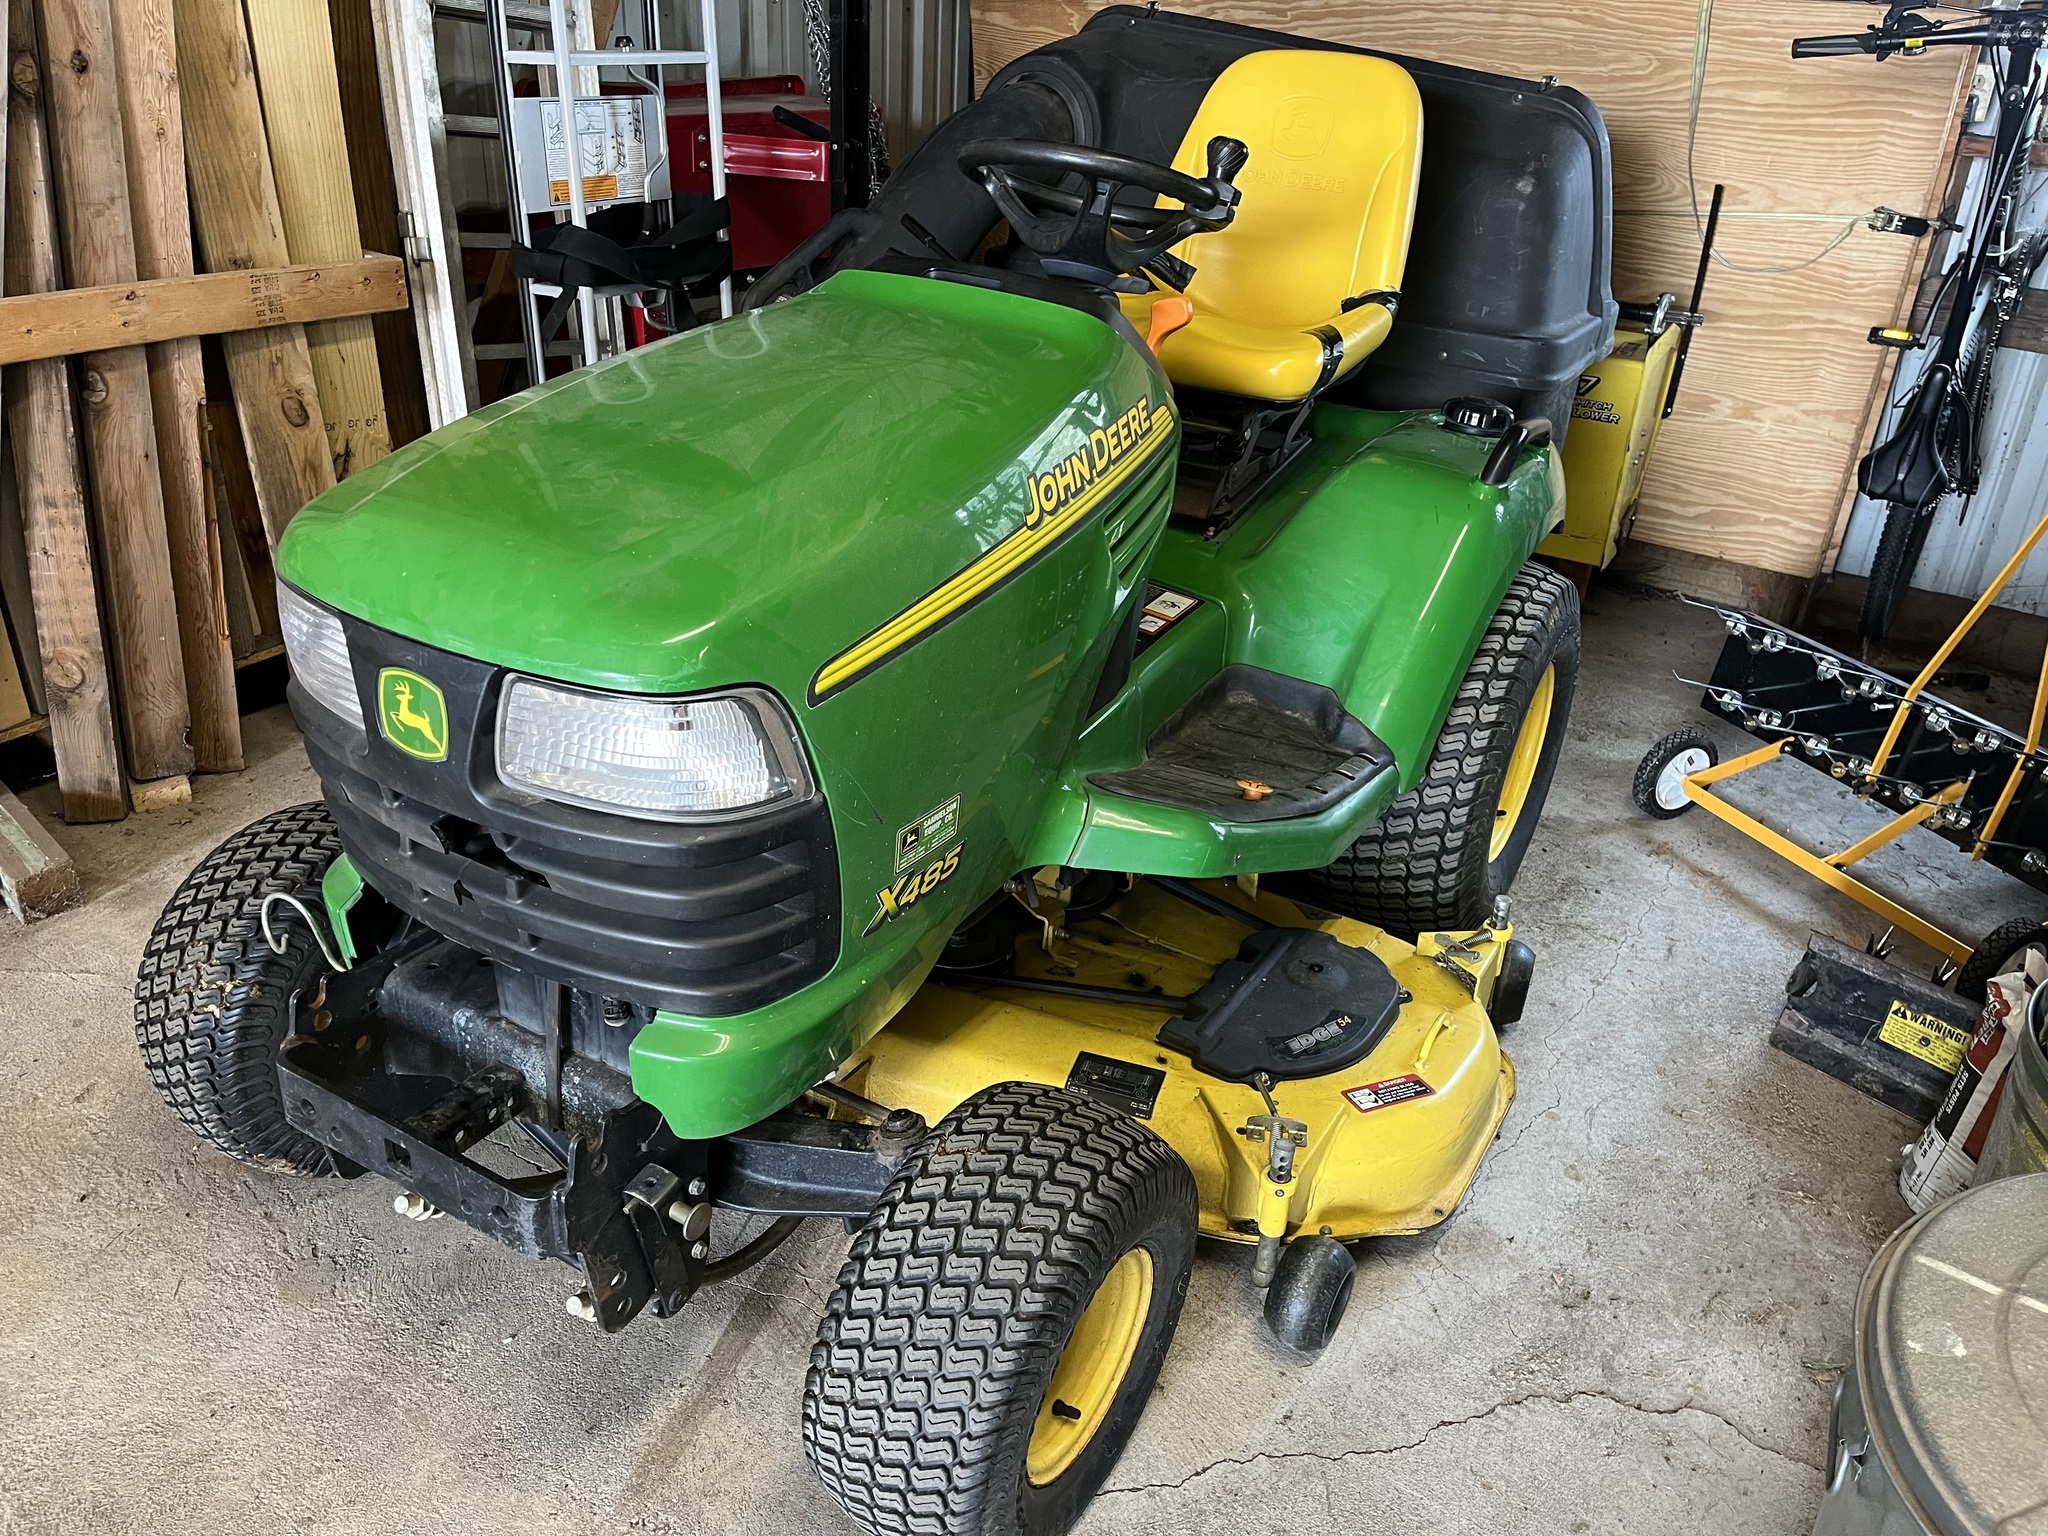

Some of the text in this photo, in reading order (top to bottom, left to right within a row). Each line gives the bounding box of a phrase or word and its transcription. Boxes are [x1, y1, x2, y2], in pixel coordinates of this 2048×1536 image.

[1237, 168, 1346, 194] JOHN DEERE
[1571, 408, 1621, 424] LOWER
[1574, 398, 1614, 411] HITCH
[1025, 394, 1152, 530] JOHN DEERE
[923, 801, 957, 828] SAMUELSON
[862, 841, 965, 937] X485
[1285, 1020, 1343, 1054] EDGE
[1337, 1015, 1351, 1027] 54
[1910, 1012, 1967, 1045] WARNING!
[1383, 1077, 1407, 1085] DANGER
[1945, 1070, 1969, 1114] SETS POSTS
